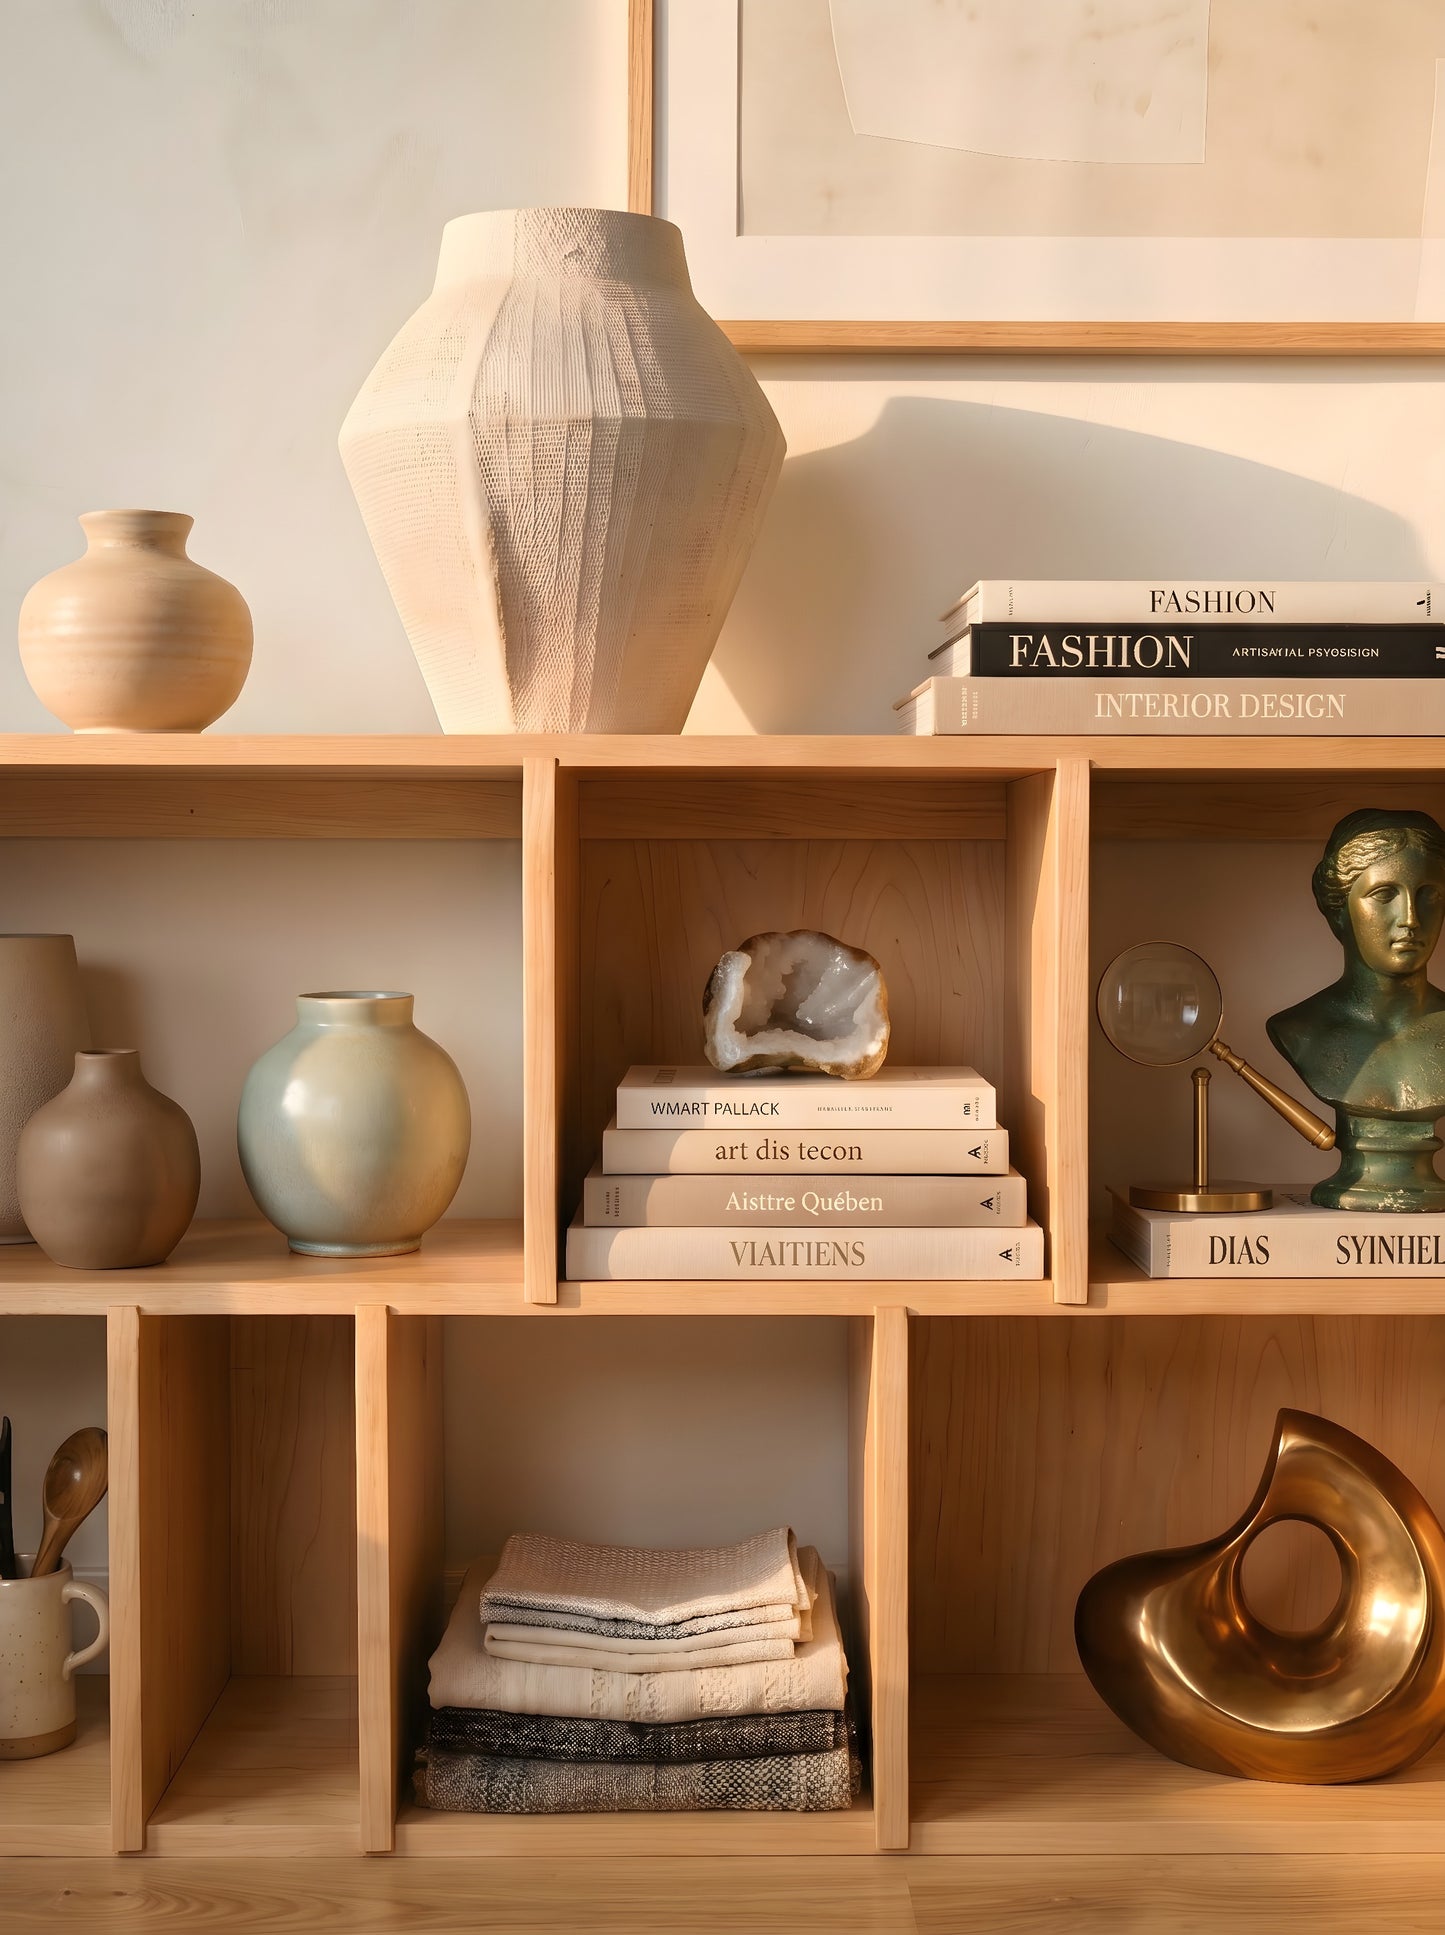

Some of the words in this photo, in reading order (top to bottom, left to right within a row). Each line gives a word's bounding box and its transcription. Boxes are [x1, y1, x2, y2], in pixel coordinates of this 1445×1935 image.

[1149, 589, 1276, 614] FASHION
[1008, 634, 1194, 669] FASHION
[1094, 692, 1233, 719] INTERIOR
[1238, 692, 1347, 719] DESIGN
[650, 1101, 710, 1116] WMART
[714, 1101, 780, 1116] PALLACK
[715, 1141, 748, 1161] art
[755, 1137, 790, 1161] dis
[797, 1141, 864, 1161] tecon
[725, 1190, 796, 1211] Aisttre
[801, 1190, 884, 1216] Quében
[729, 1240, 866, 1267] VIAITIENS
[1208, 1234, 1271, 1266] DIAS
[1336, 1234, 1445, 1265] SYINHEL
